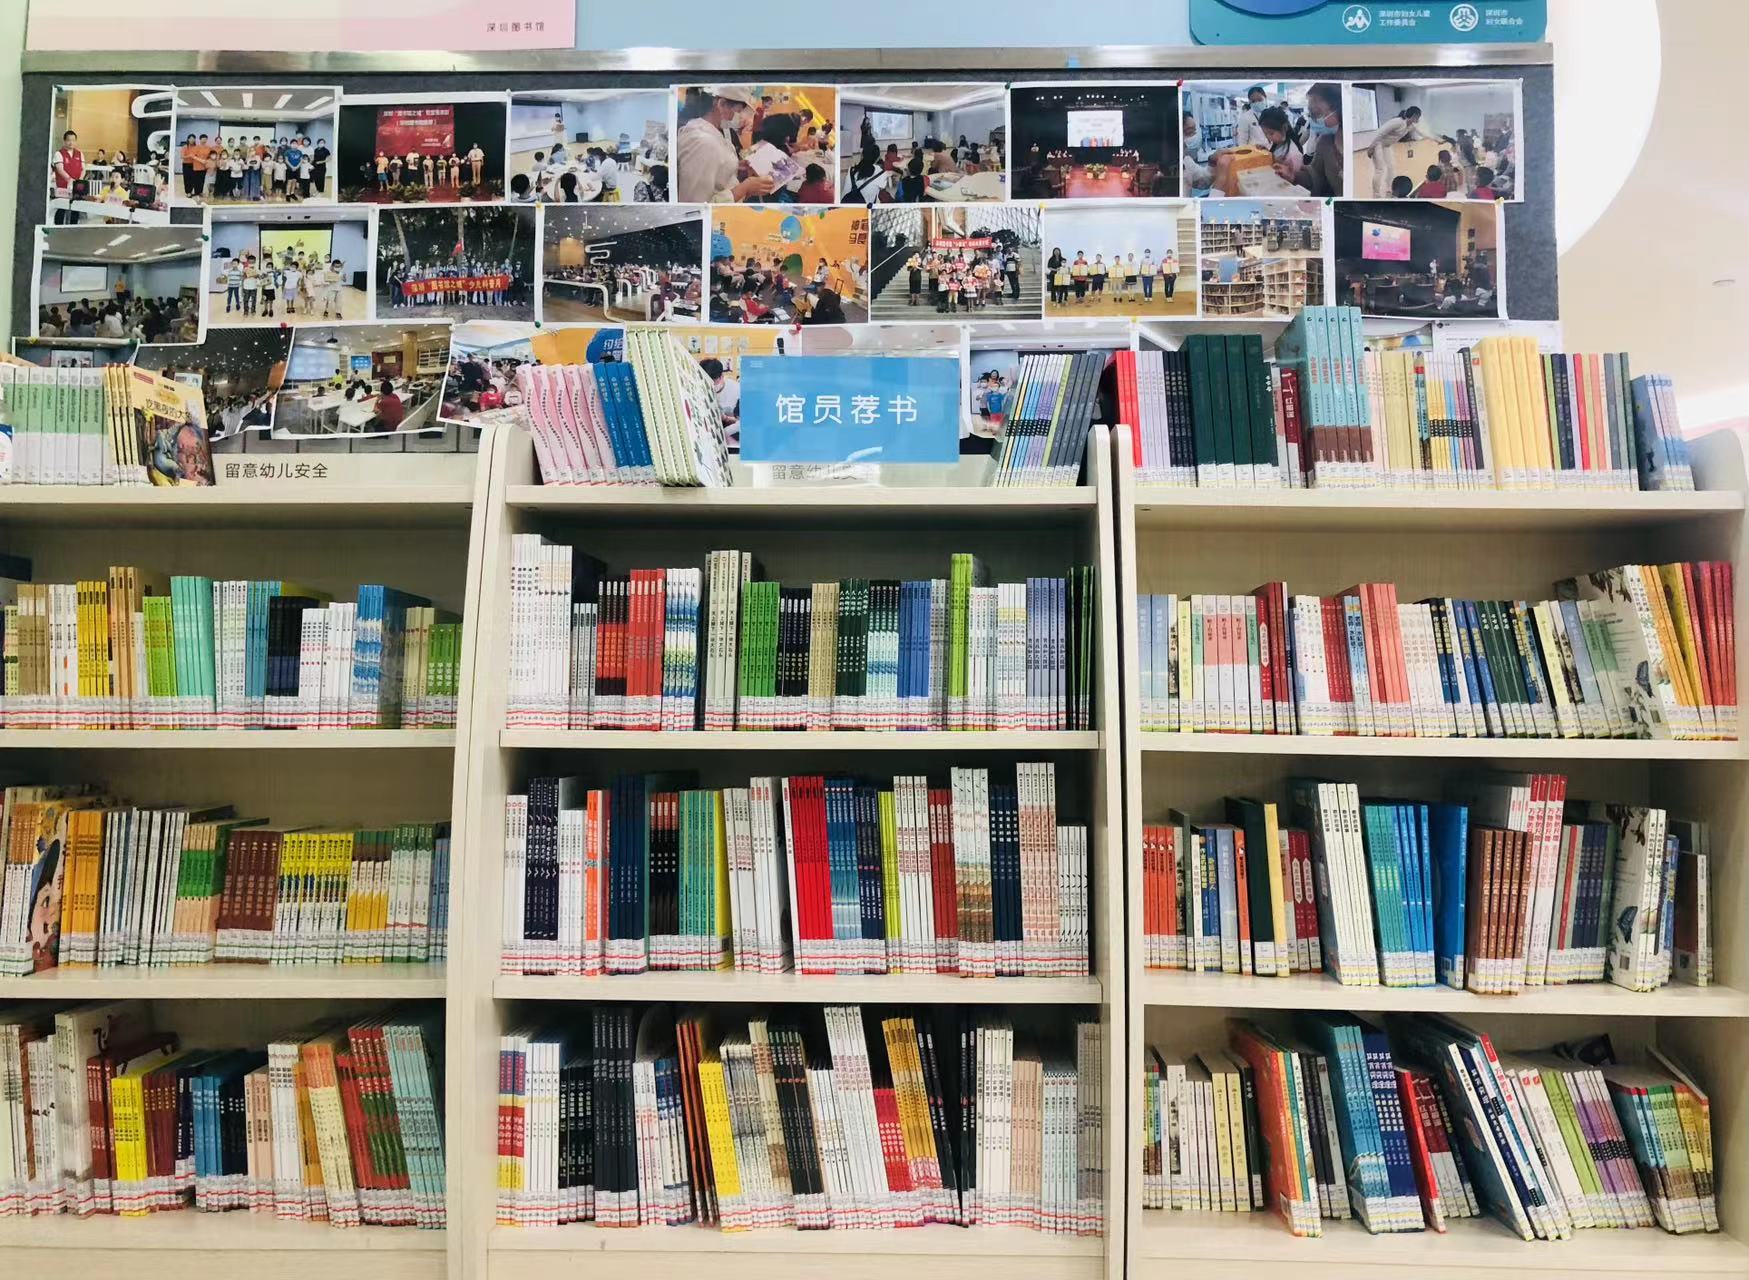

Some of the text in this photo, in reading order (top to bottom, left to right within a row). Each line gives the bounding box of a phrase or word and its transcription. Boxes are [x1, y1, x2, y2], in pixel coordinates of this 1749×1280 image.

[775, 394, 918, 425] 馆员荐书
[225, 462, 328, 480] 留意幼儿安全
